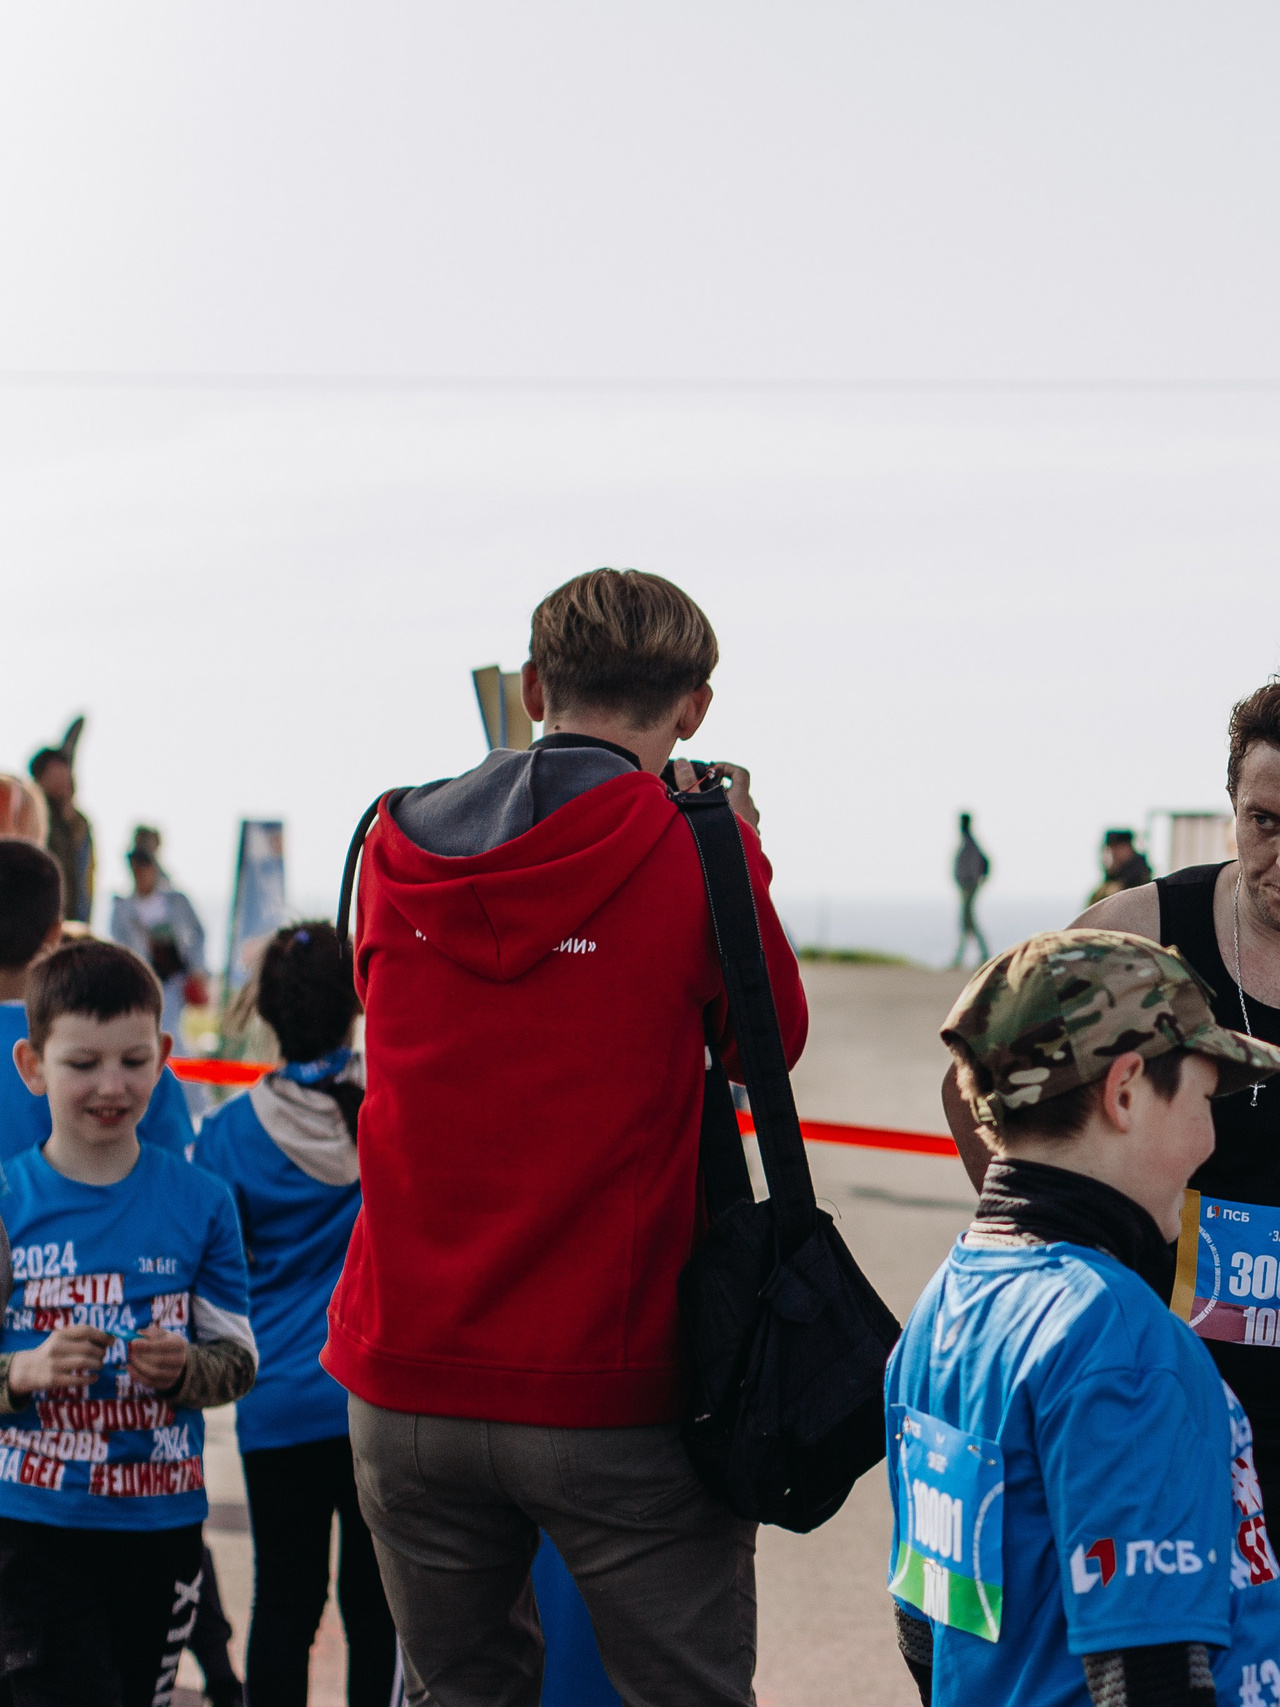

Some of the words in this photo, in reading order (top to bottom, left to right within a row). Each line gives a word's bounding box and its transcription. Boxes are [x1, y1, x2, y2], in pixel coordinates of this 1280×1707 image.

[1223, 1208, 1250, 1223] ПСБ
[12, 1241, 77, 1280] 2024
[25, 1274, 123, 1307] #МЕЧТА
[0, 1427, 109, 1463] ЛЮБОВЬ
[150, 1423, 190, 1462] 2024
[1126, 1540, 1203, 1576] ПСБ
